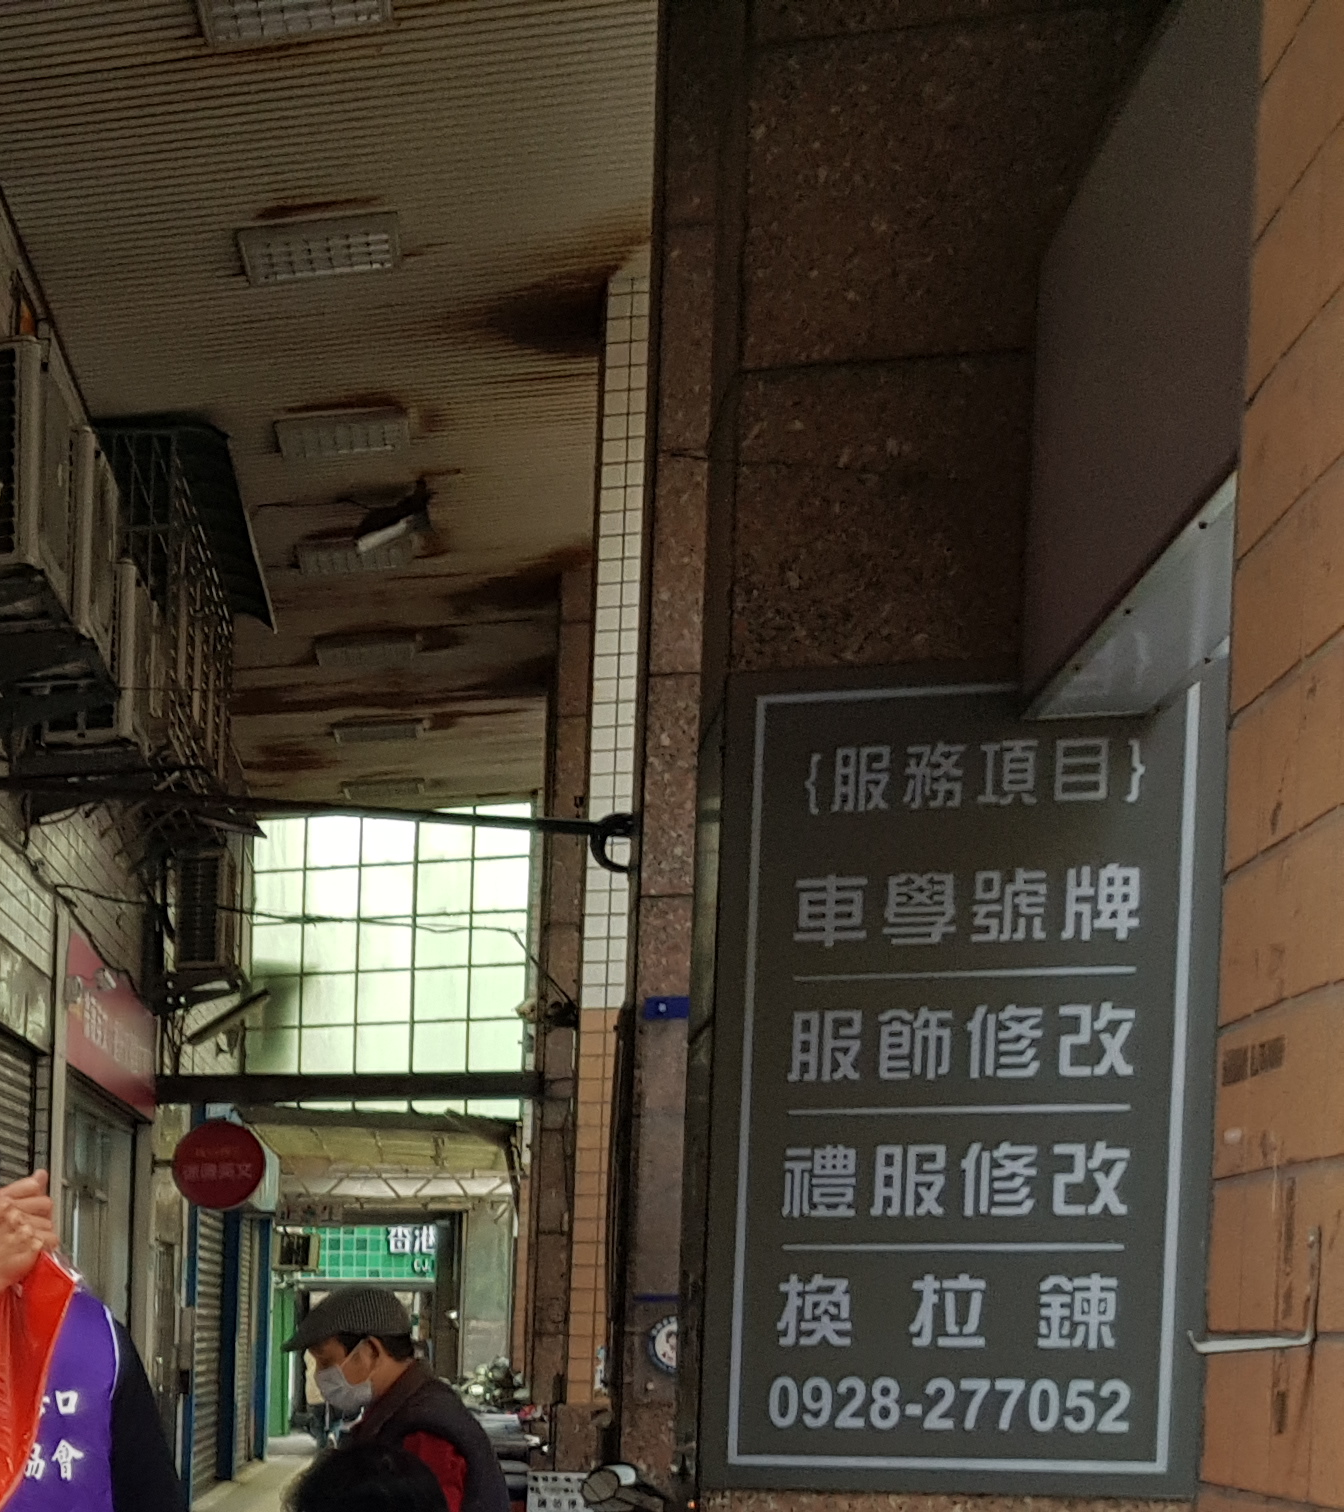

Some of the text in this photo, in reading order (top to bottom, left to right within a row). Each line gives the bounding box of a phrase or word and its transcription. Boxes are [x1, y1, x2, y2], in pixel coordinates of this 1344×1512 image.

[794, 863, 1141, 947] 車學號牌
[787, 1003, 1135, 1082] 服飾修改
[781, 1141, 1130, 1219] 禮服修改
[768, 1376, 1132, 1432] 0928-277052
